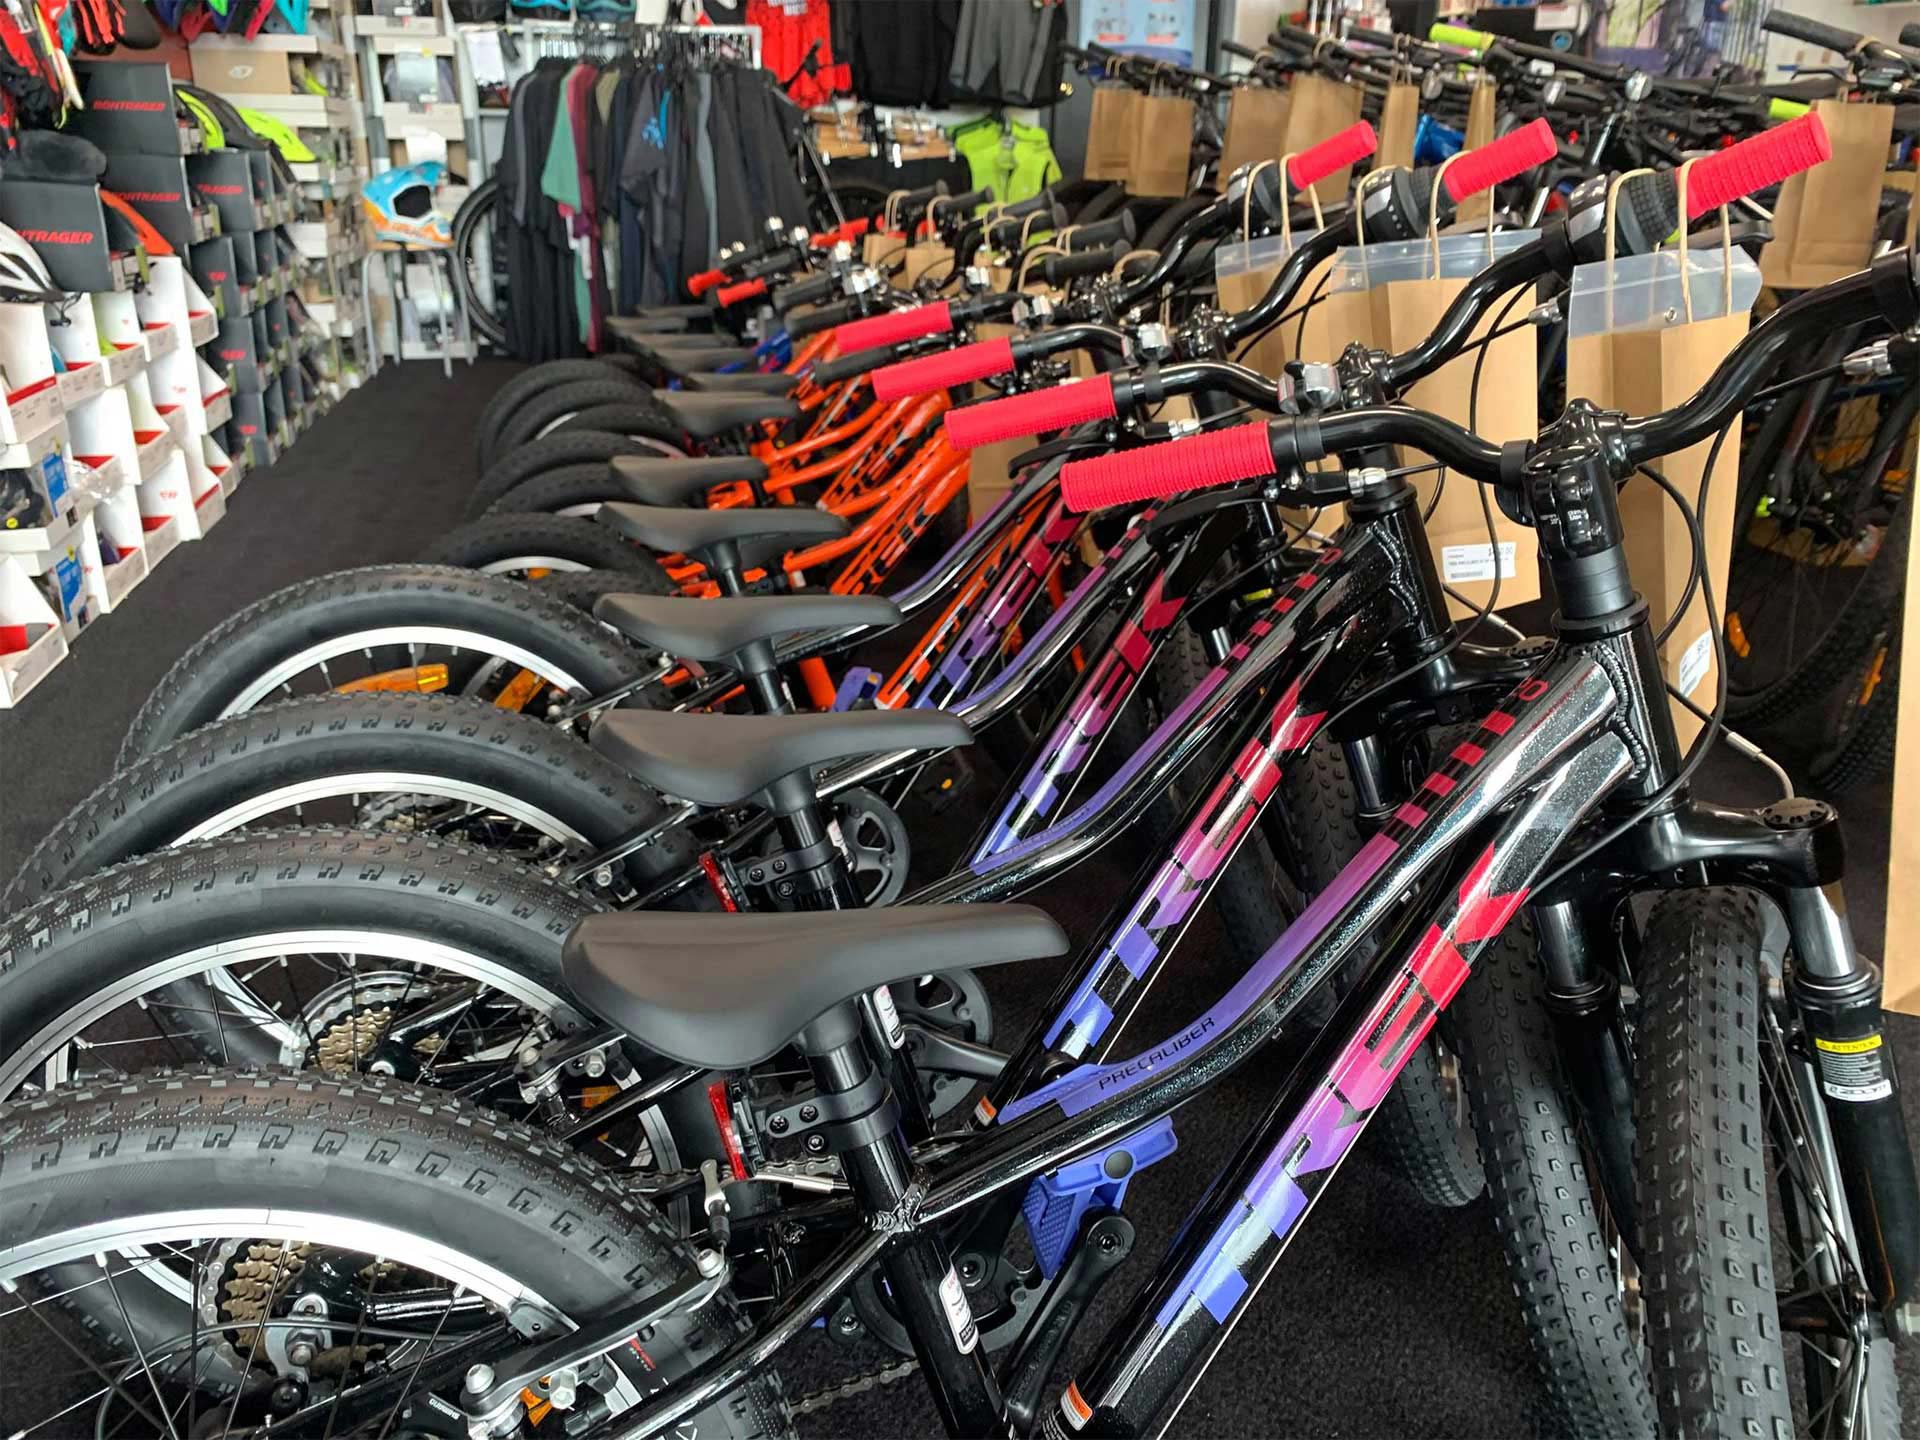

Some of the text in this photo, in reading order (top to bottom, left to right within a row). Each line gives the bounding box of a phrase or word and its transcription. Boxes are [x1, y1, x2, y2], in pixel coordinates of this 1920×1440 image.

[972, 567, 1185, 866] TREK
[1043, 672, 1329, 1048] TREK
[1098, 1015, 1217, 1090] PRECALIBER
[1156, 840, 1531, 1328] TREK
